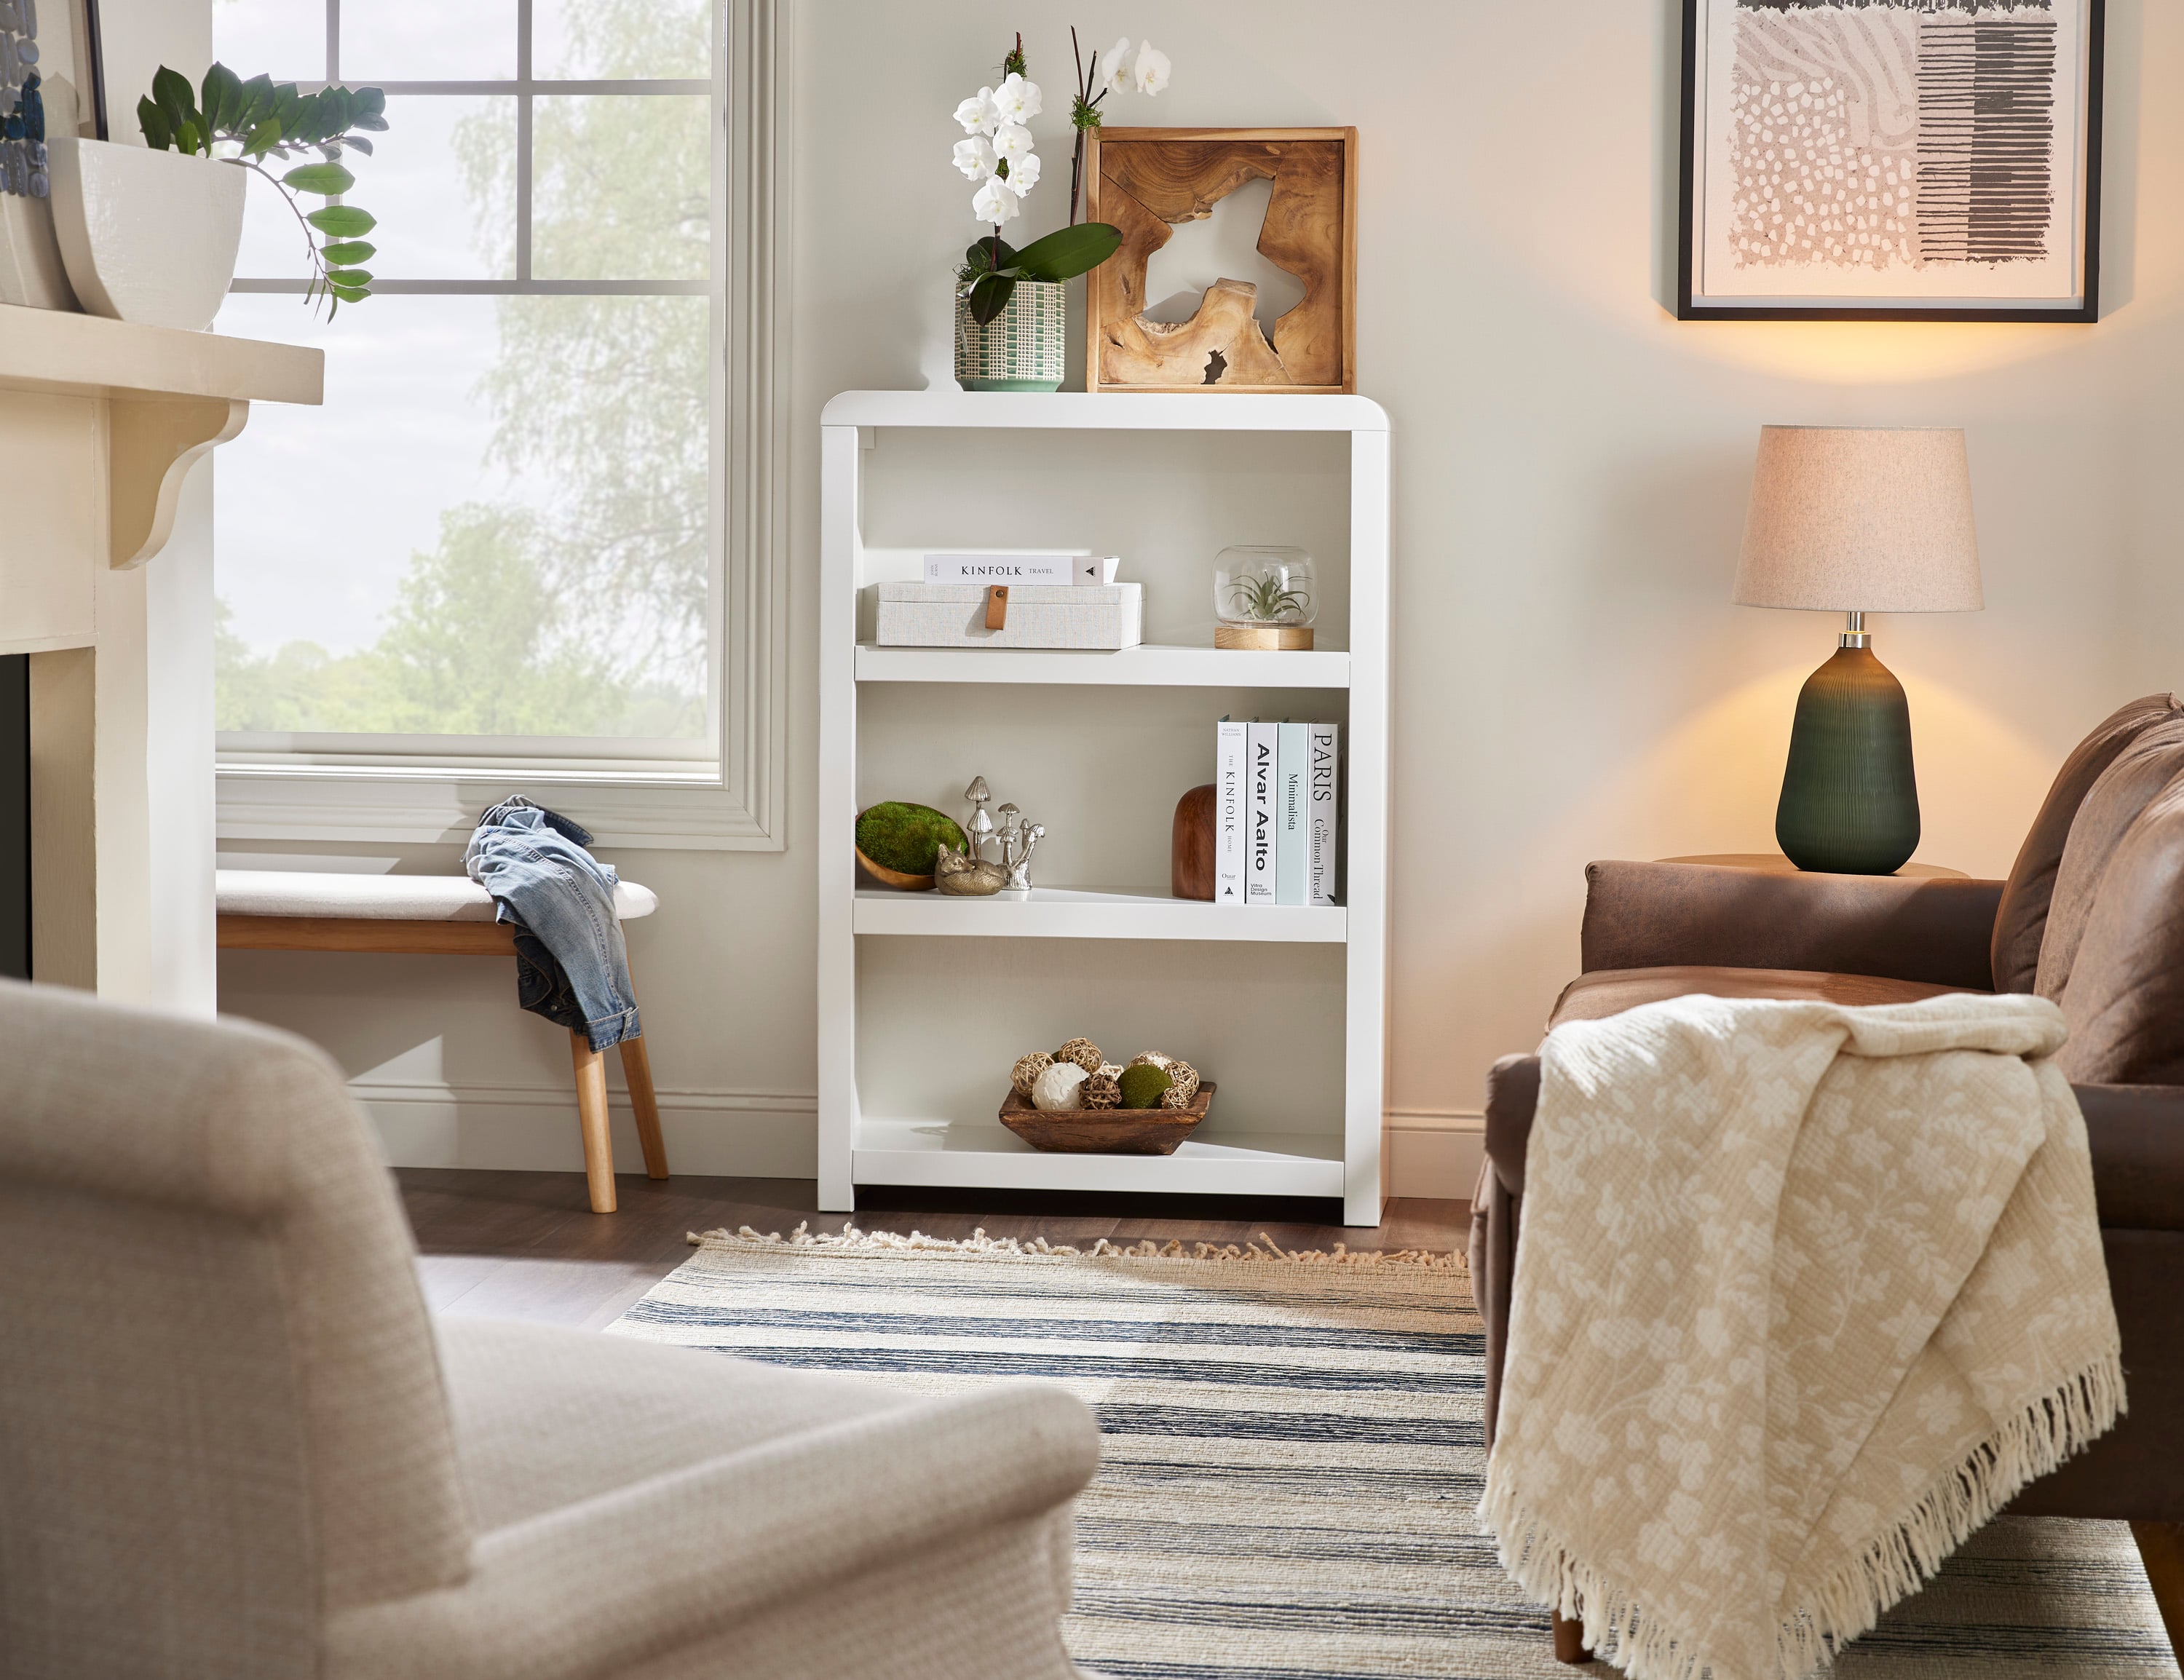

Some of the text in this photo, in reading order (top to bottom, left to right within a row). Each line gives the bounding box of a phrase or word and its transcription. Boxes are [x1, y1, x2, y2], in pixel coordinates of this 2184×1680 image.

[961, 566, 1023, 576] KINFOLK
[1313, 733, 1332, 801] PARIS
[1225, 772, 1235, 832] KINFOLK
[1256, 742, 1270, 871] Alvar Aalto
[1288, 774, 1298, 830] Minimalista
[1313, 819, 1324, 899] Common Thread
